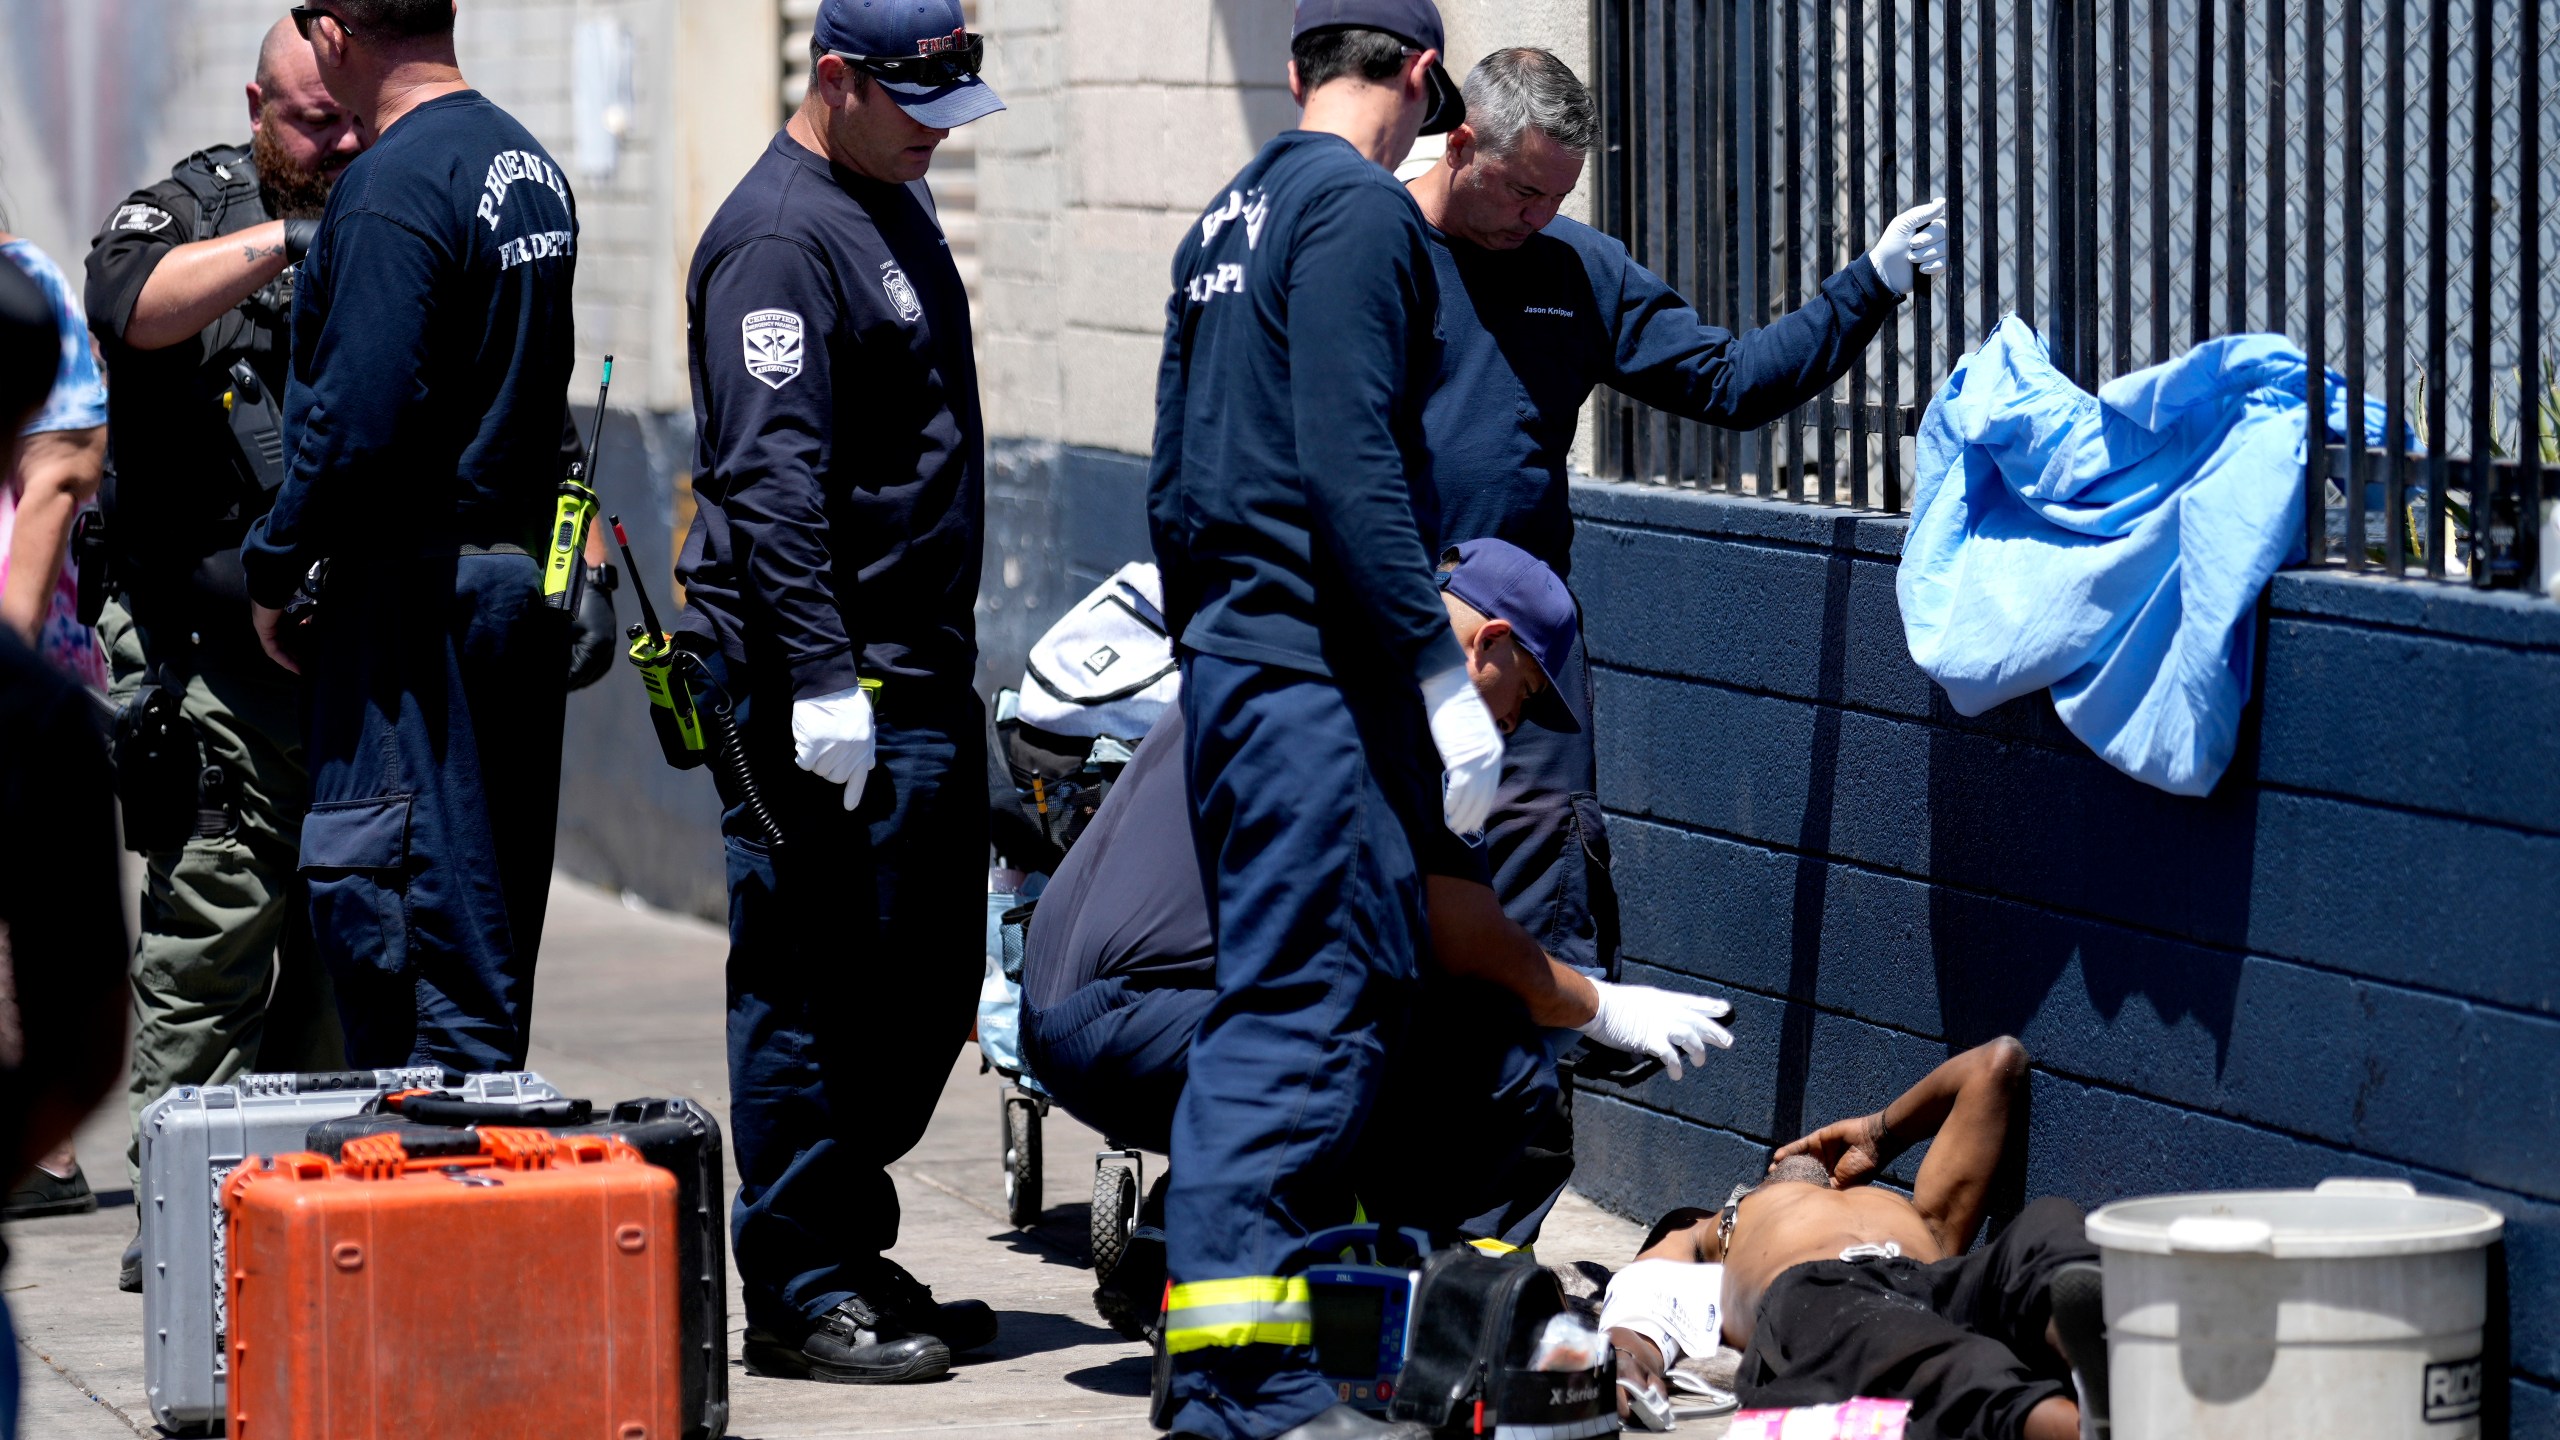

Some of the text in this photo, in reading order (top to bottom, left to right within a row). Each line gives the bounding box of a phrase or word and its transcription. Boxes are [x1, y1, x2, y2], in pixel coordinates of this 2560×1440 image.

[477, 150, 569, 231] PHOENIX
[1523, 305, 1547, 314] Jason
[747, 314, 798, 325] CERTIFIED
[756, 366, 794, 375] ARIZONA
[1549, 1384, 1599, 1405] X Series
